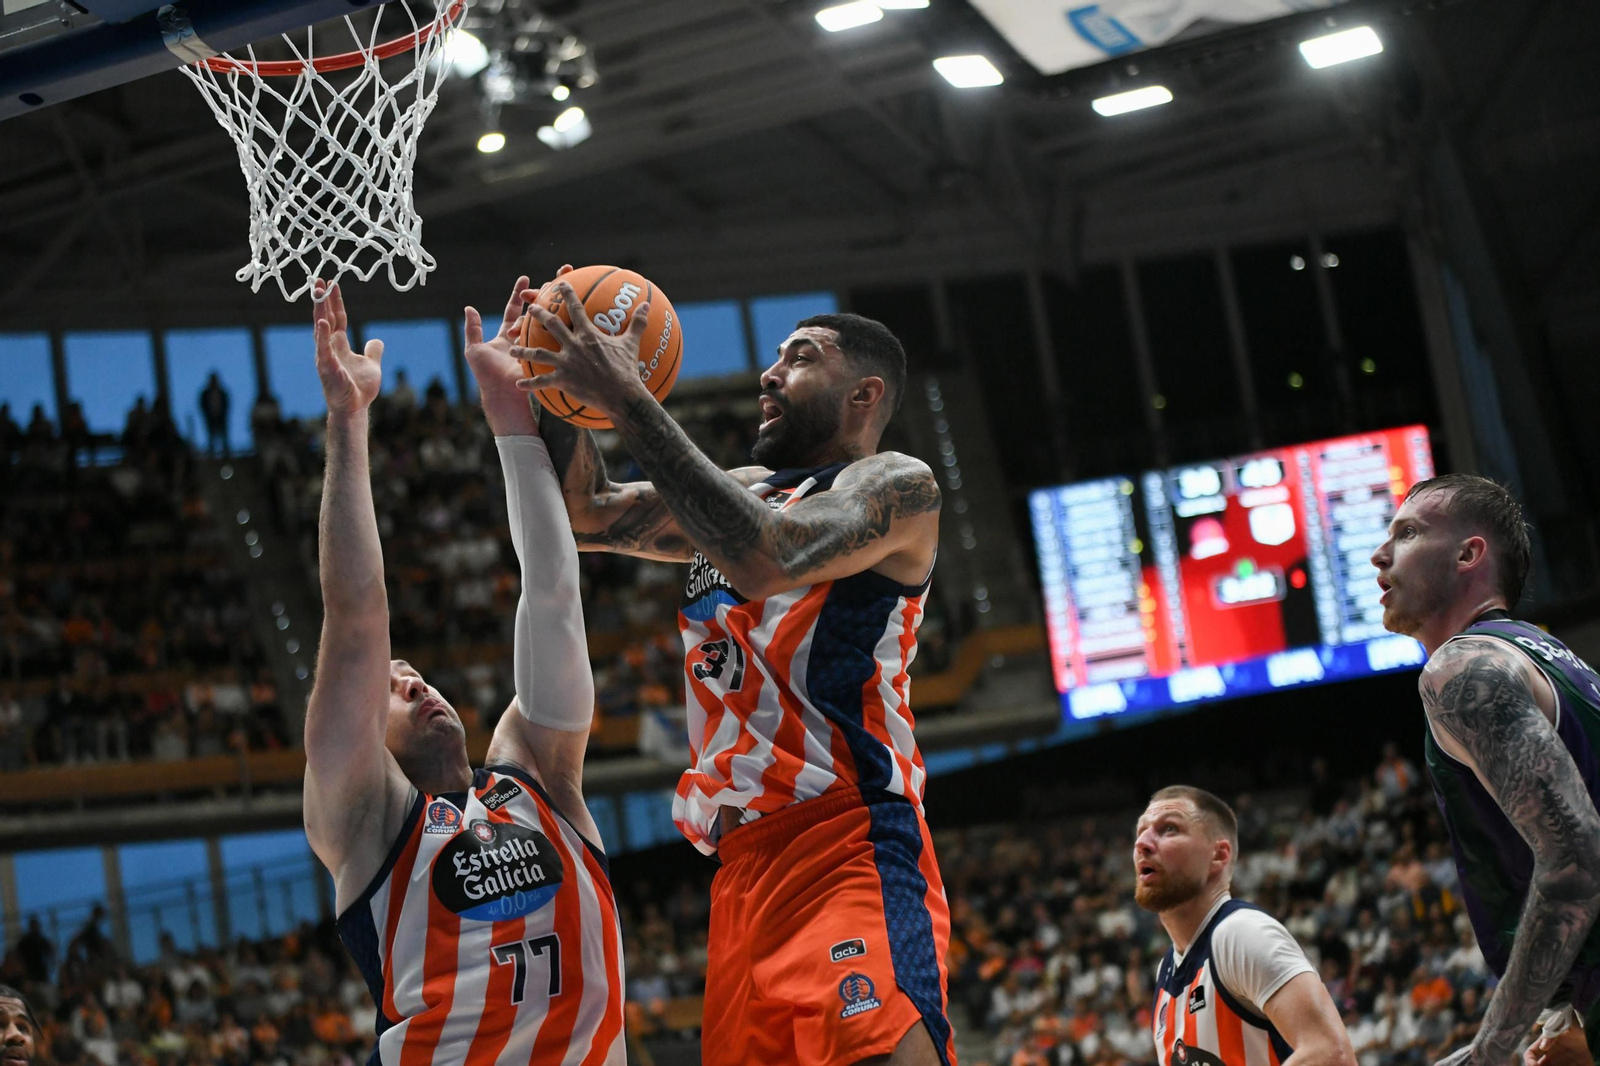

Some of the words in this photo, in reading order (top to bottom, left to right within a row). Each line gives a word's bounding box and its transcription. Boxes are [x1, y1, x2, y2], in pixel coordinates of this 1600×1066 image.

[593, 282, 641, 334] lson
[650, 310, 672, 369] endesa
[692, 635, 746, 693] 31
[484, 793, 500, 805] liga
[490, 787, 519, 809] endesa
[452, 838, 540, 878] Estrella
[463, 861, 546, 900] Galicia
[501, 890, 527, 916] 0,0
[490, 932, 562, 1006] 77
[834, 946, 858, 959] acb
[846, 998, 875, 1009] BASQUET
